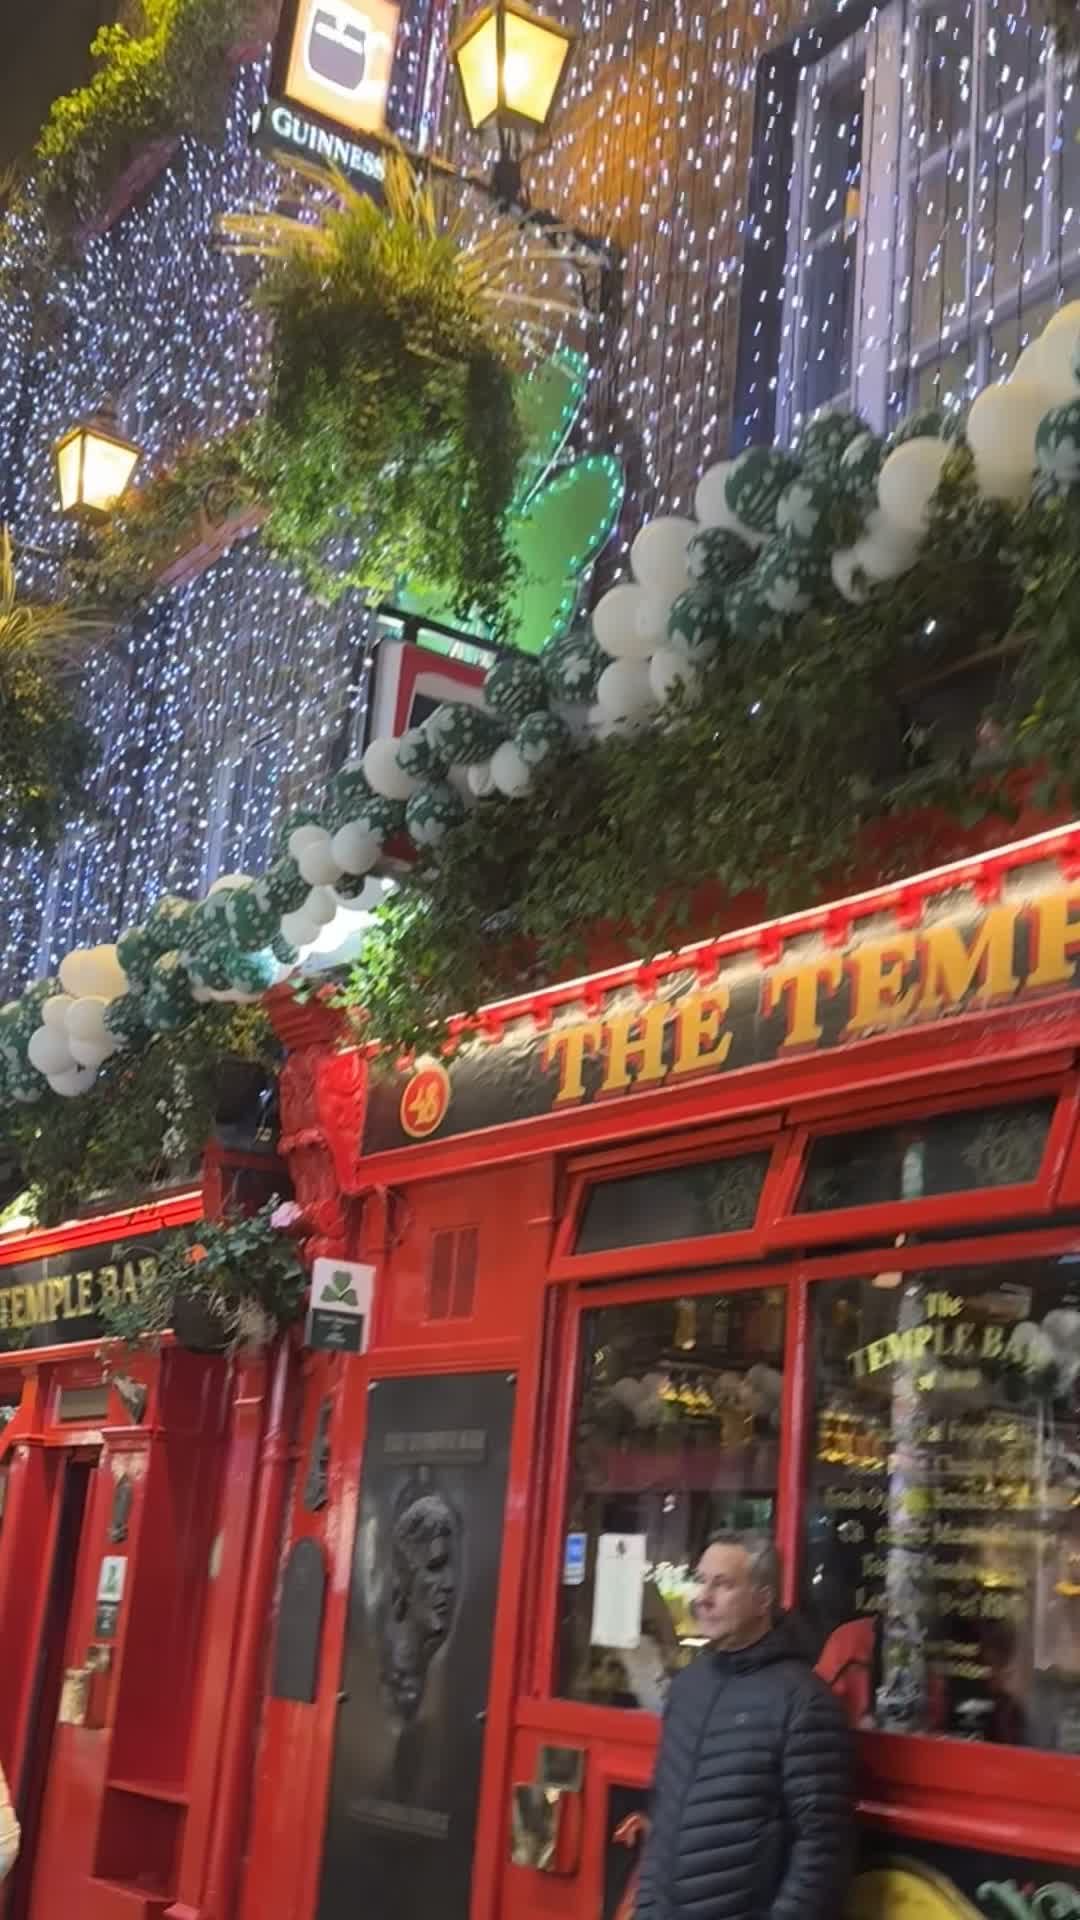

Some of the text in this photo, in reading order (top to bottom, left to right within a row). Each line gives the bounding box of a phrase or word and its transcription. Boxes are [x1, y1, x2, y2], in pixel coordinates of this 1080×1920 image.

[271, 106, 386, 182] GUINNESS
[545, 980, 734, 1102] THE
[848, 1323, 976, 1374] TEMPLE
